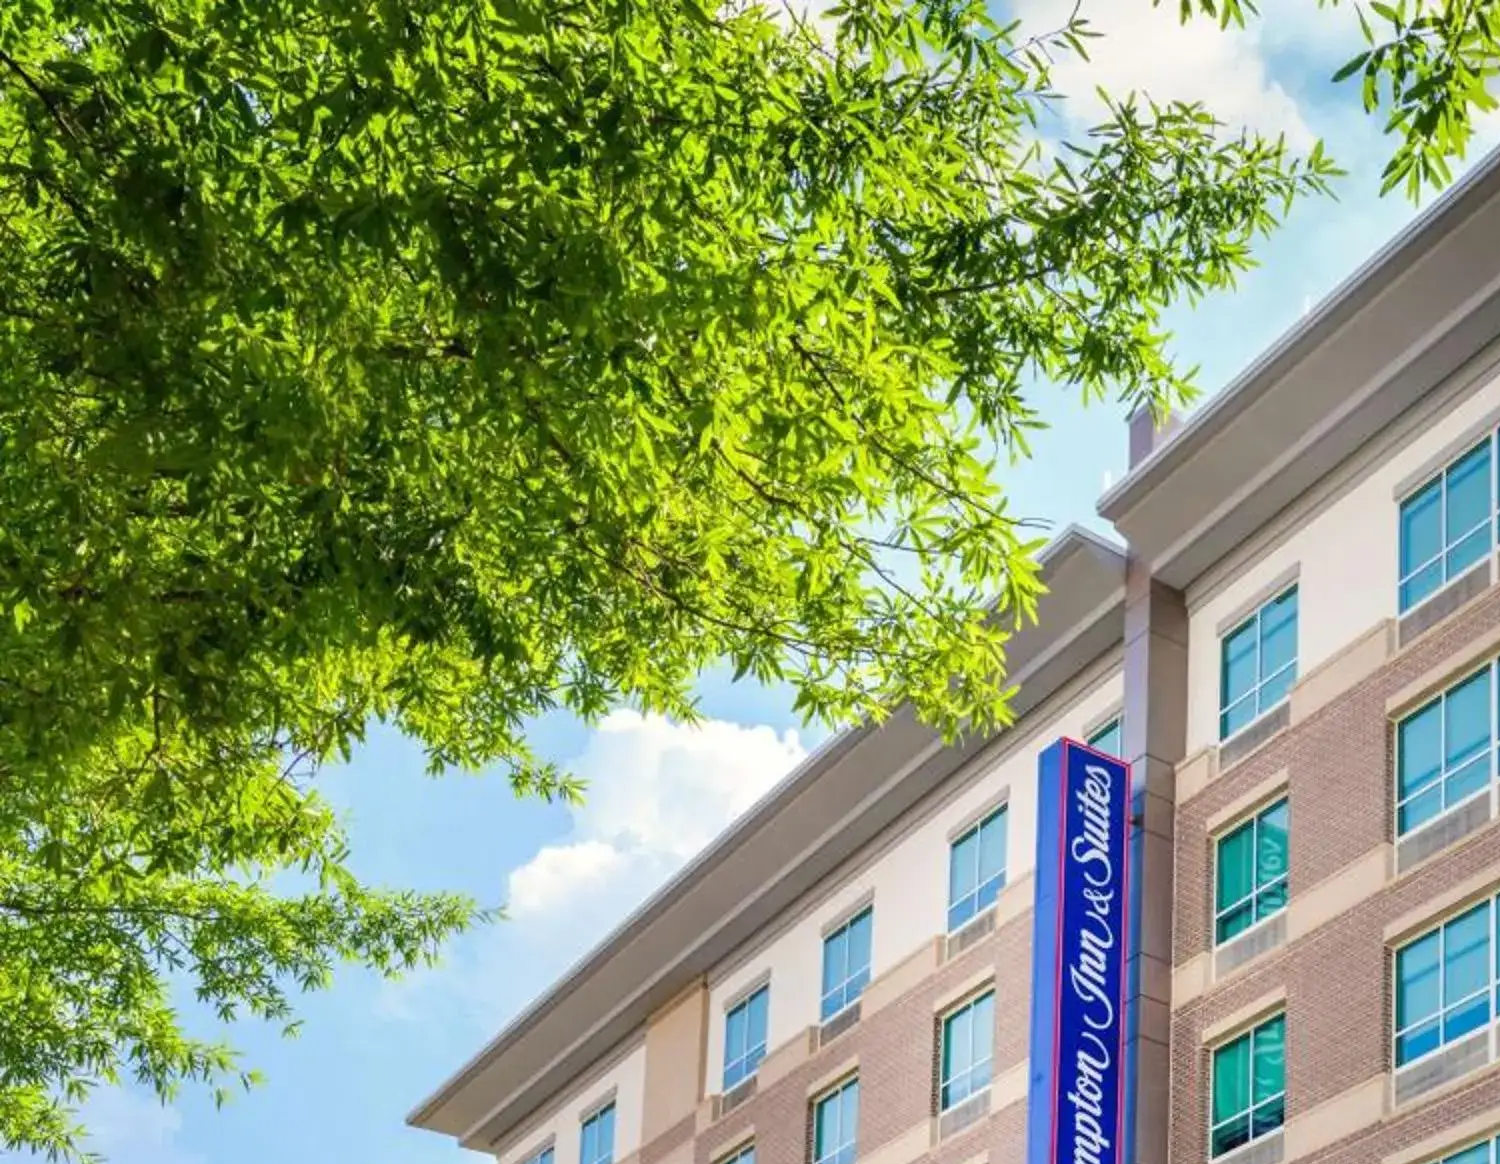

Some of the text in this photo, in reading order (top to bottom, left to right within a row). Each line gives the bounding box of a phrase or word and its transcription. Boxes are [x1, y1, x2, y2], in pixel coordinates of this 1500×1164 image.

[1072, 764, 1113, 887] Suites
[1083, 888, 1115, 916] &
[1070, 910, 1114, 1030] Inn
